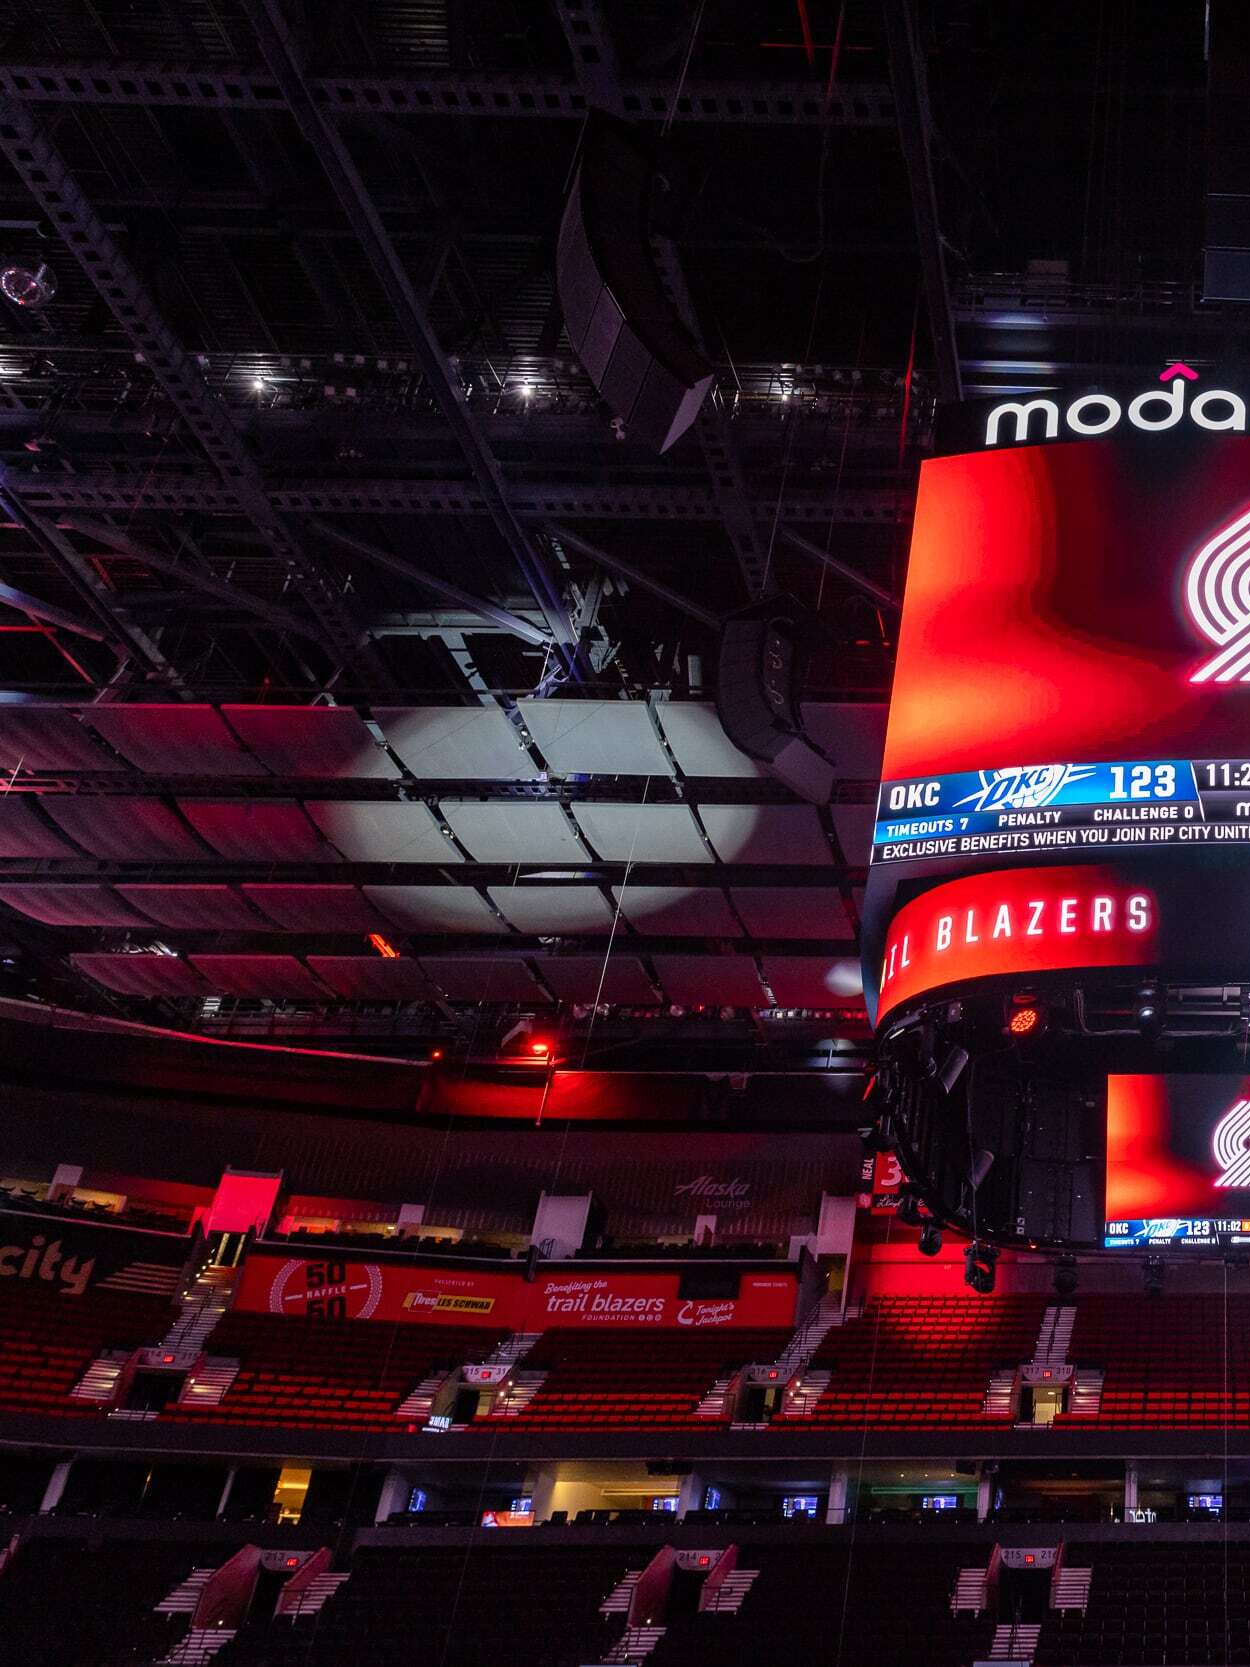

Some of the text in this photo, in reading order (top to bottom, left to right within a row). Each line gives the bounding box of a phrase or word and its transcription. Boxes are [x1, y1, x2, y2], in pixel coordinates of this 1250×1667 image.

[1109, 764, 1176, 799] 123
[890, 782, 941, 810] OKC
[998, 811, 1062, 827] PENALTY
[1094, 806, 1194, 821] CHALLENGE 0
[887, 818, 969, 837] TIMEOUTS 7
[883, 839, 957, 859] EXCLUSIVE
[961, 833, 1029, 851] BENEFITS
[1033, 830, 1076, 846] WHEN
[1080, 828, 1108, 843] YOU
[1112, 828, 1146, 842] JOIN
[1150, 827, 1174, 840] RIP
[1179, 825, 1211, 840] CITY
[936, 896, 1147, 952] BLAZERS
[673, 1176, 751, 1198] Alaska
[1109, 1223, 1128, 1234] OKC
[1186, 1221, 1210, 1235] 123
[0, 1234, 95, 1294] city
[307, 1263, 346, 1288] 50
[593, 1280, 607, 1288] the
[546, 1294, 665, 1312] trail blazers
